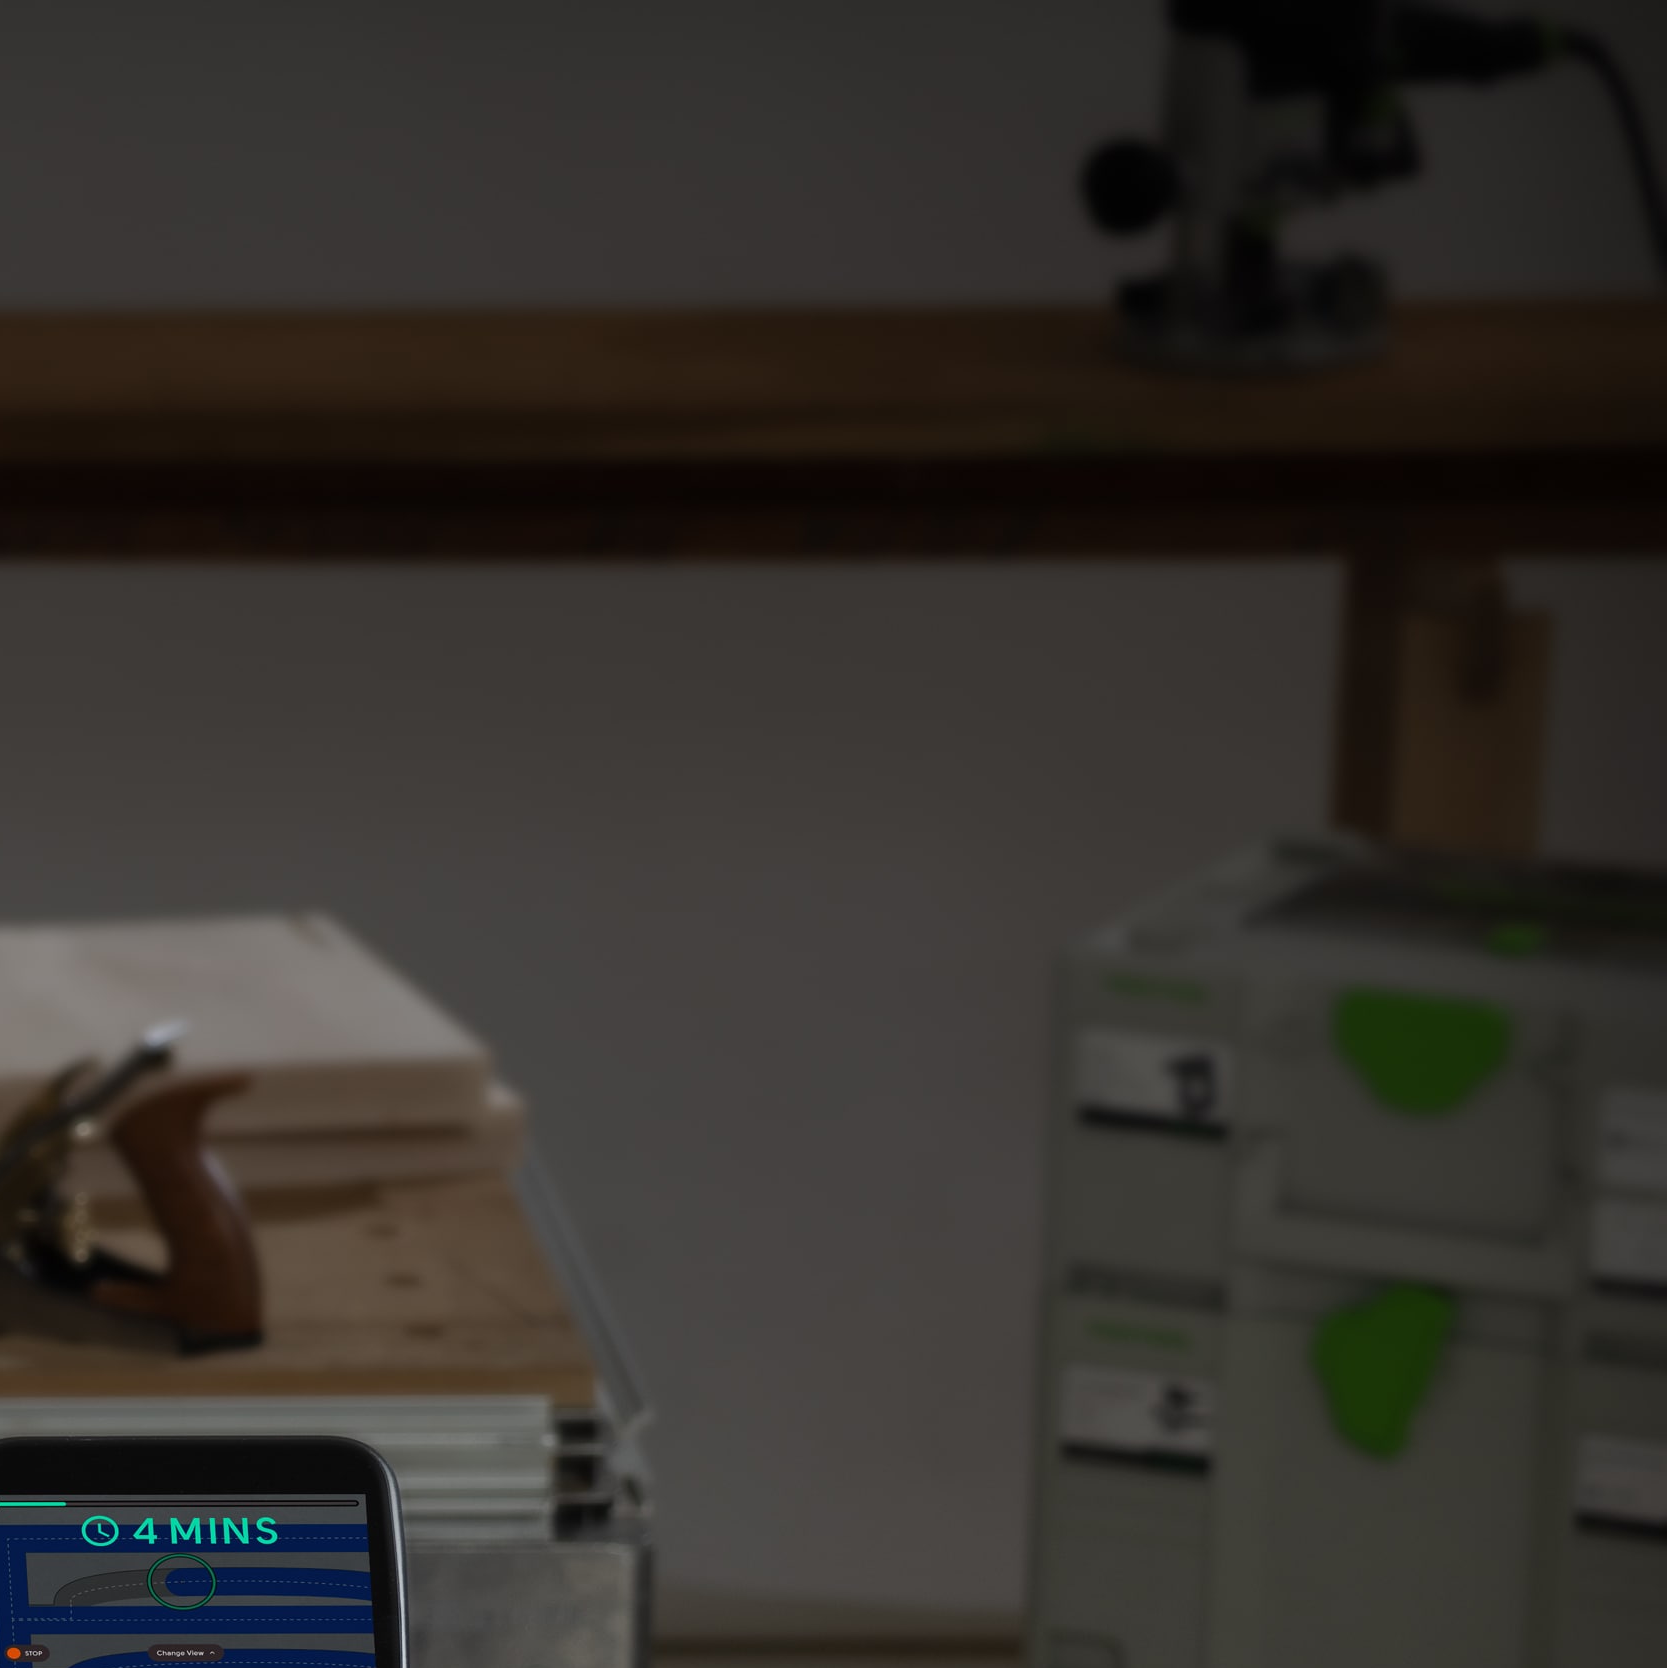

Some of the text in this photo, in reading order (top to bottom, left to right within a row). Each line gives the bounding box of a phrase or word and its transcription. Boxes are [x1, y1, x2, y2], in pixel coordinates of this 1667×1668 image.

[132, 1516, 278, 1545] 4 MINS
[156, 1649, 205, 1659] Change View
